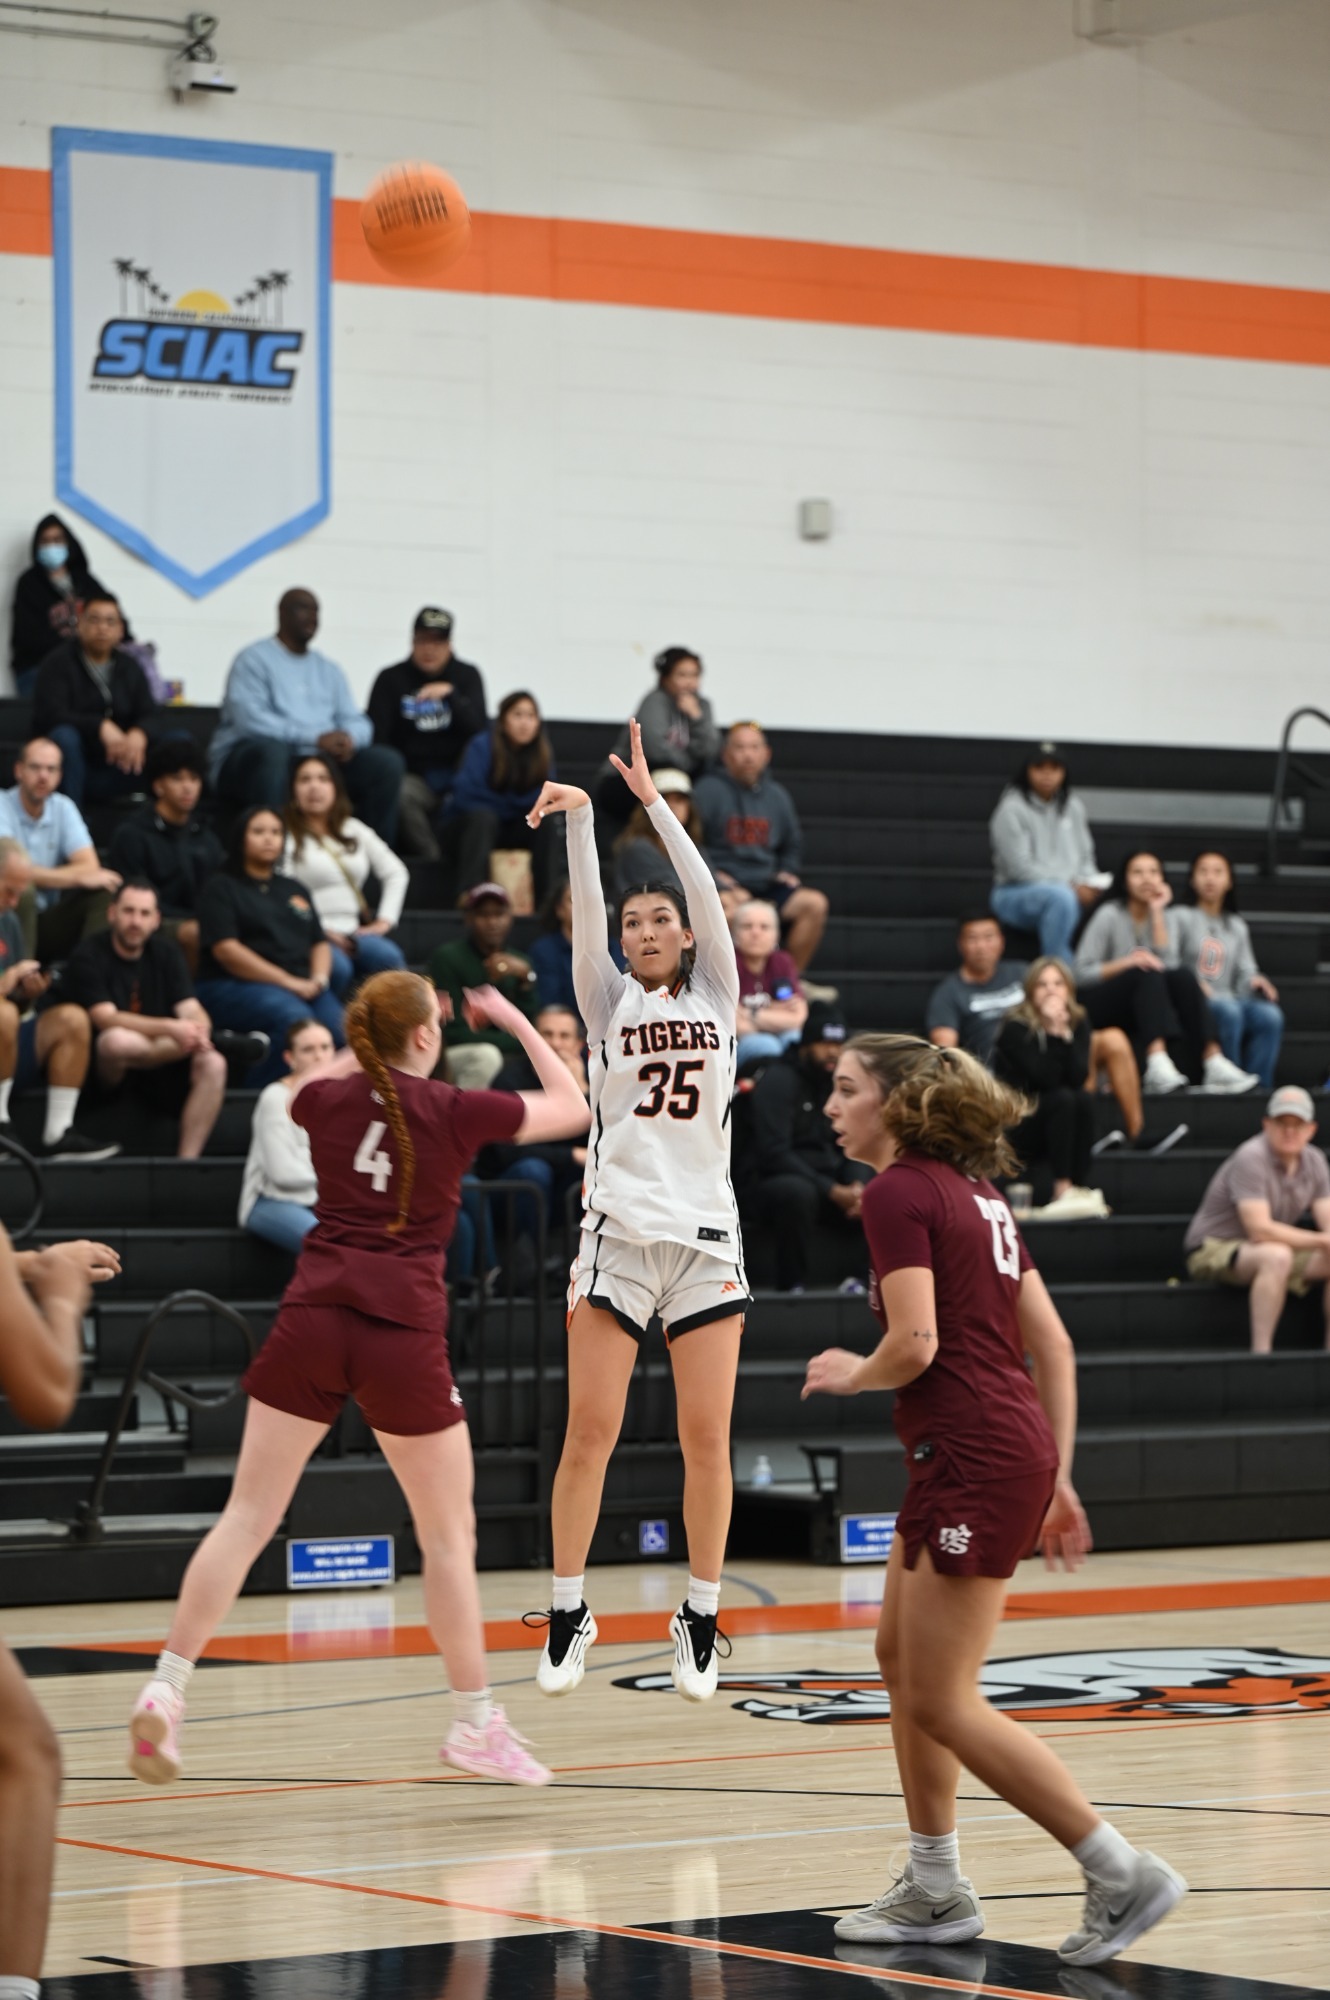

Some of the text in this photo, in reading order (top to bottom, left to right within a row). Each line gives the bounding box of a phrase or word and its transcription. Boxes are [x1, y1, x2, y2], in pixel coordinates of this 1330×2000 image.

[93, 318, 304, 389] SCIAC
[620, 1021, 721, 1057] TIGERS
[633, 1059, 705, 1120] 35
[352, 1120, 393, 1193] 4
